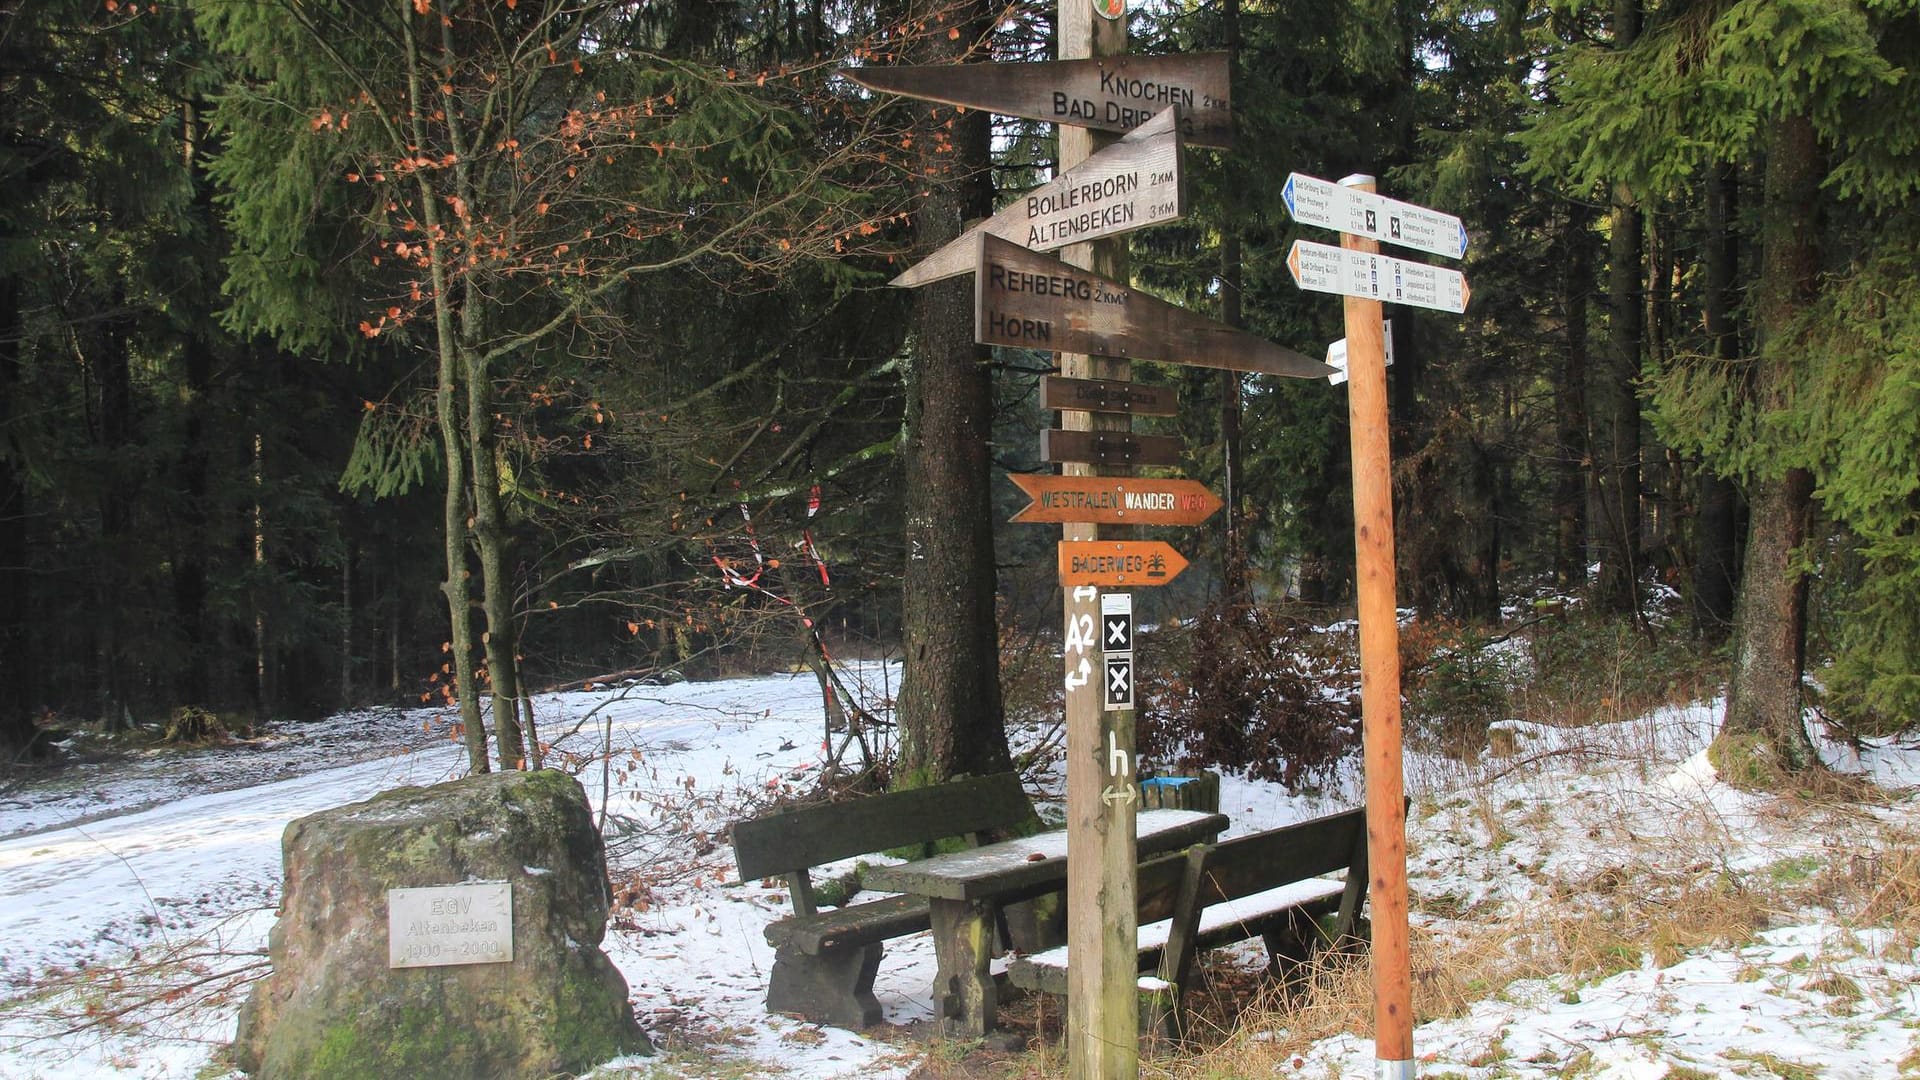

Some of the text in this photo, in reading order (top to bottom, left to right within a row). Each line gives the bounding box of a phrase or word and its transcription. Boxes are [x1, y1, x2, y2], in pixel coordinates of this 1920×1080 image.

[1053, 91, 1096, 120] BAD
[1101, 70, 1193, 107] KNOCHEN
[1027, 171, 1138, 219] BOLLERBORN
[1027, 201, 1134, 247] ALTENBEKEN
[990, 262, 1091, 300] REHBERG
[989, 311, 1051, 342] HORN
[1041, 491, 1207, 511] WESTFALEN WANDER WEG
[1065, 613, 1095, 655] A2
[1109, 730, 1129, 777] h
[431, 896, 473, 916] EGV
[407, 919, 498, 937] Altenbeken
